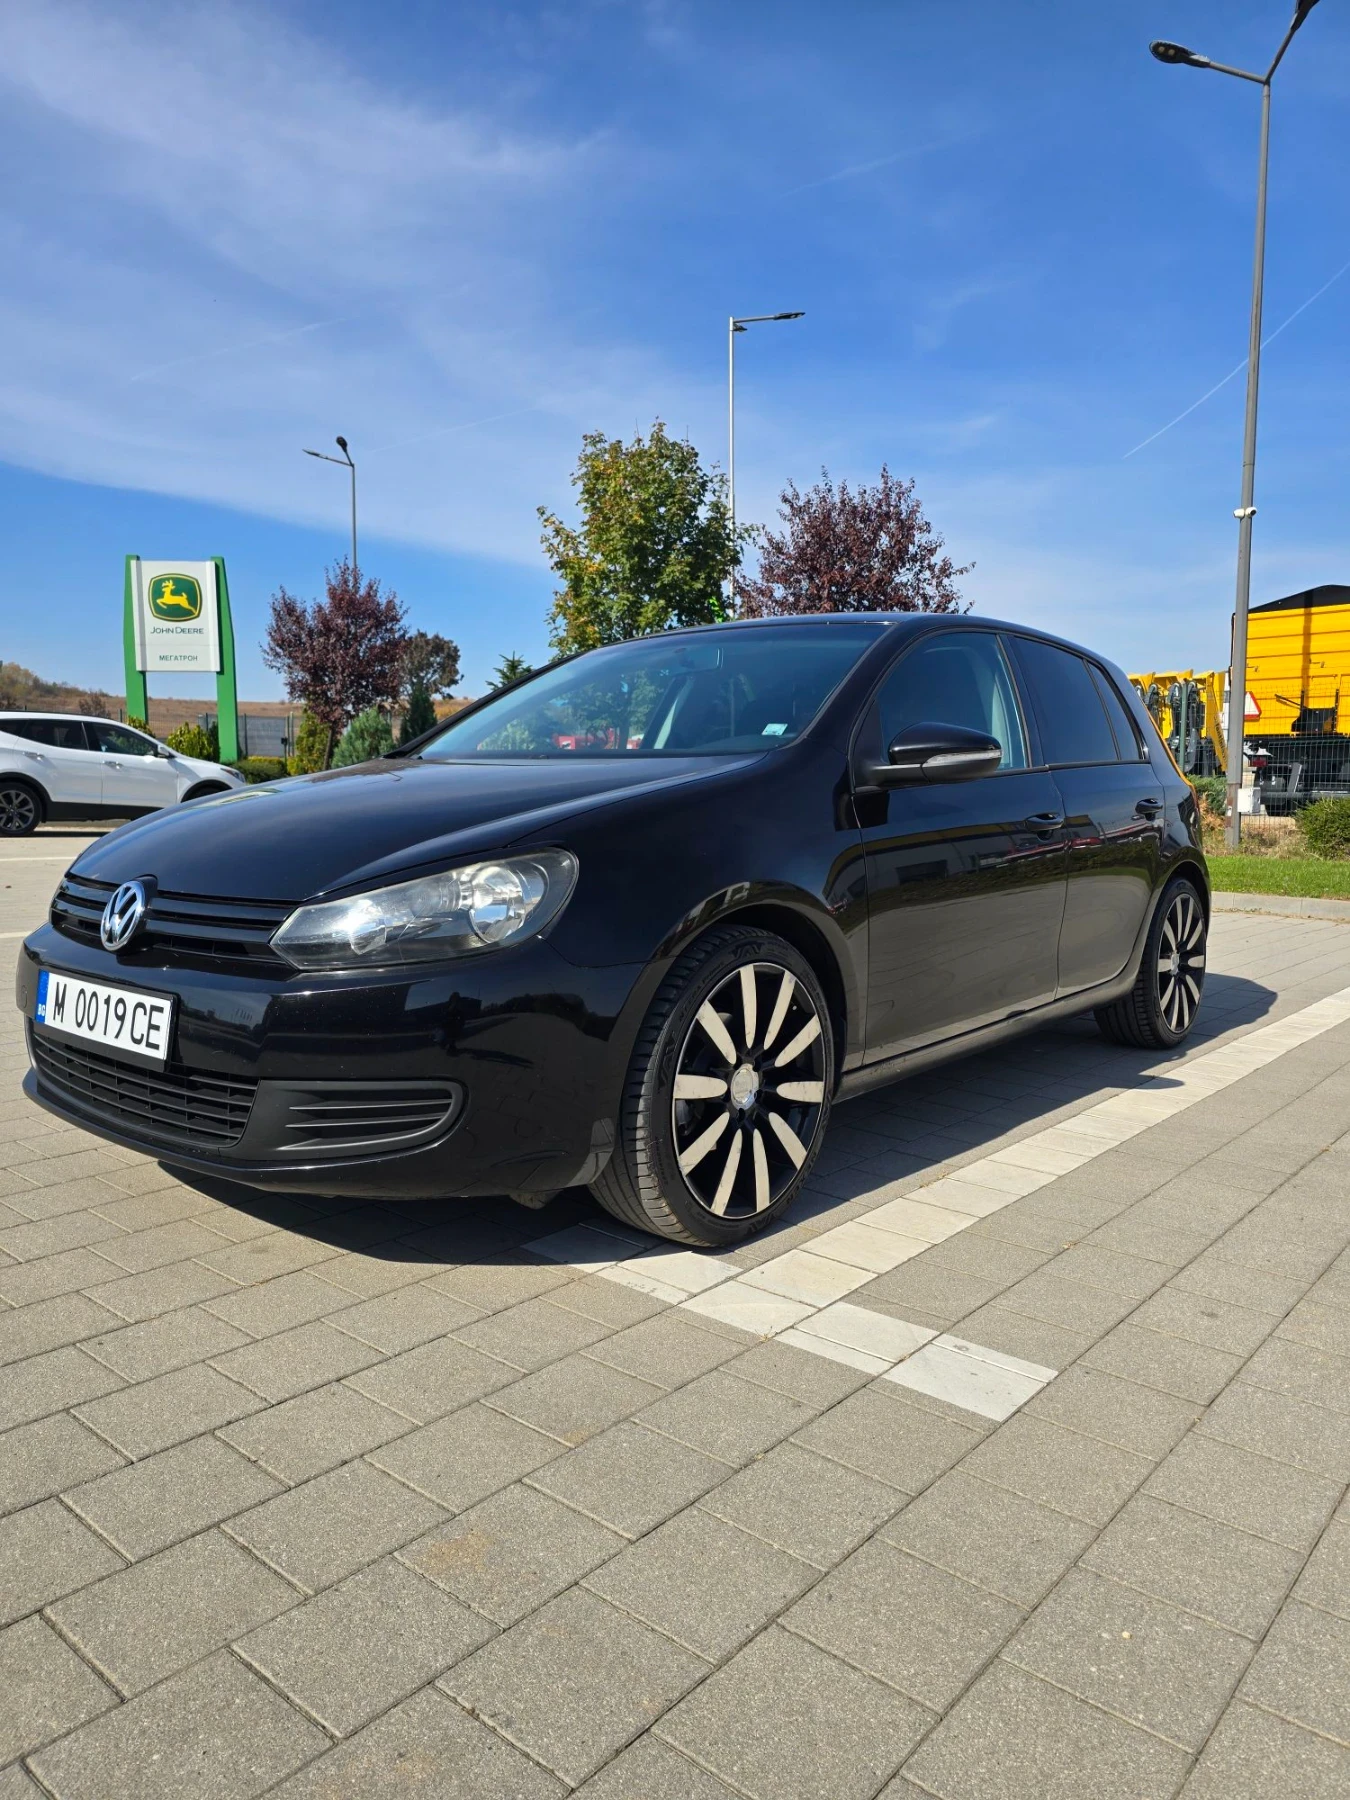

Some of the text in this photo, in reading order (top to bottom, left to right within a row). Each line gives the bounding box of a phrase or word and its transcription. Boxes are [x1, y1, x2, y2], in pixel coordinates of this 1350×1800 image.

[150, 626, 204, 634] JOHN DEERE
[53, 981, 67, 1023] M
[38, 1003, 46, 1017] BG
